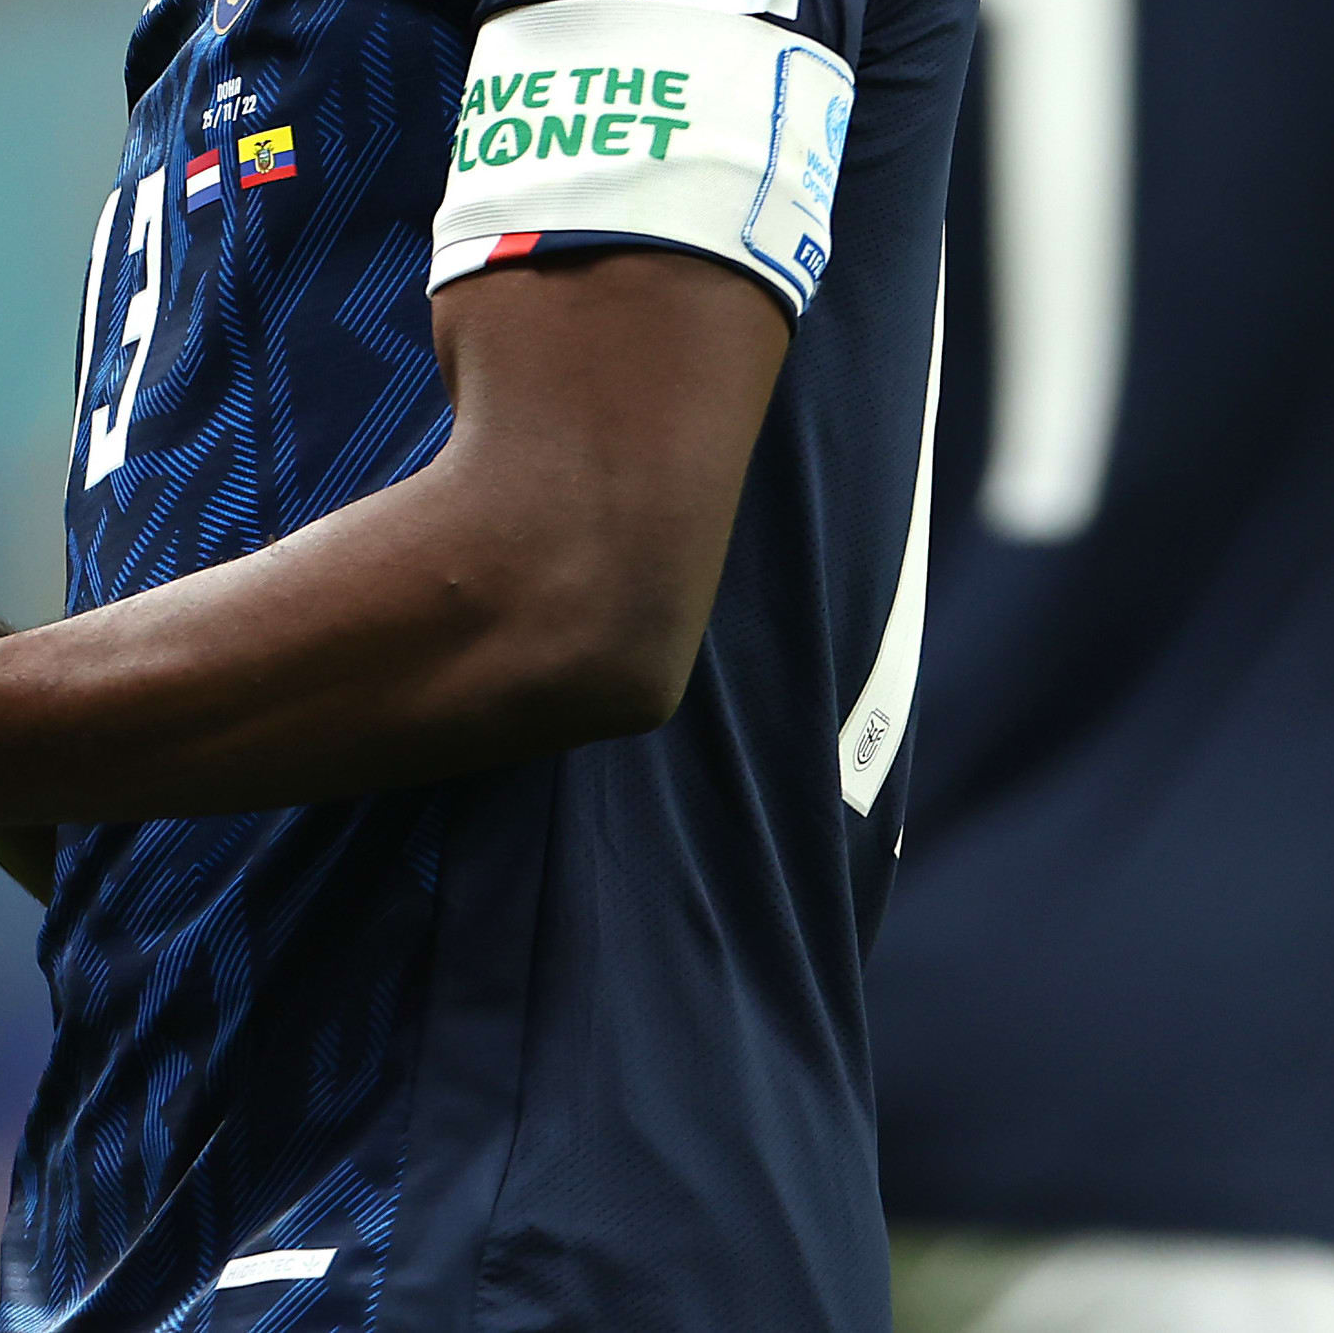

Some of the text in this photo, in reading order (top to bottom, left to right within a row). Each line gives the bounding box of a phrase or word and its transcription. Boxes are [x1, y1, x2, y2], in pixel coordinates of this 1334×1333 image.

[217, 76, 242, 103] DOHA
[460, 67, 690, 121] AVE THE
[65, 165, 166, 491] 13
